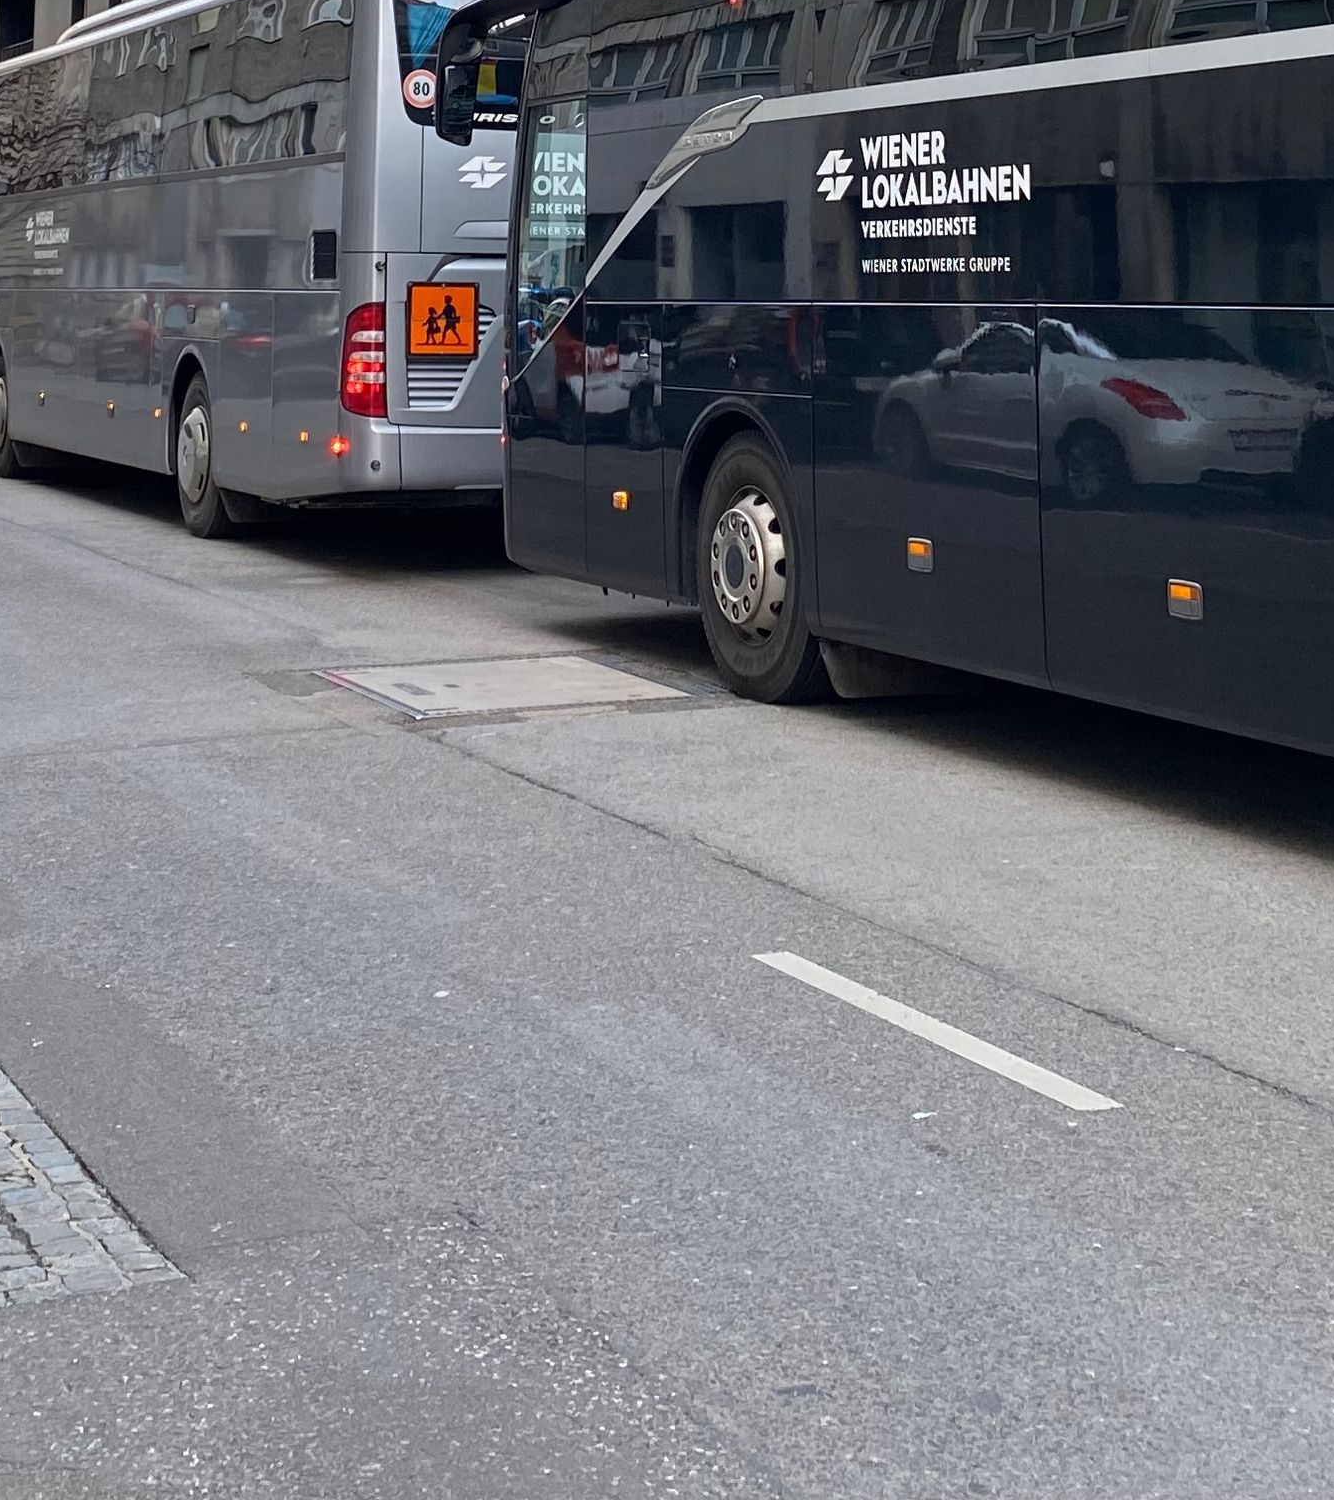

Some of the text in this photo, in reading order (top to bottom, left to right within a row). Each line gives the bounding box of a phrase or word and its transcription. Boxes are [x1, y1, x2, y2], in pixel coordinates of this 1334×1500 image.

[412, 81, 430, 96] 80
[860, 130, 946, 171] WIENER
[861, 164, 1031, 209] LOKALBAHNEN
[34, 227, 70, 245] LOKALBAHNEN
[860, 216, 977, 239] VERKEHRSDIENSTE
[861, 256, 1011, 273] WIENER STADTWERKE GRUPPE
